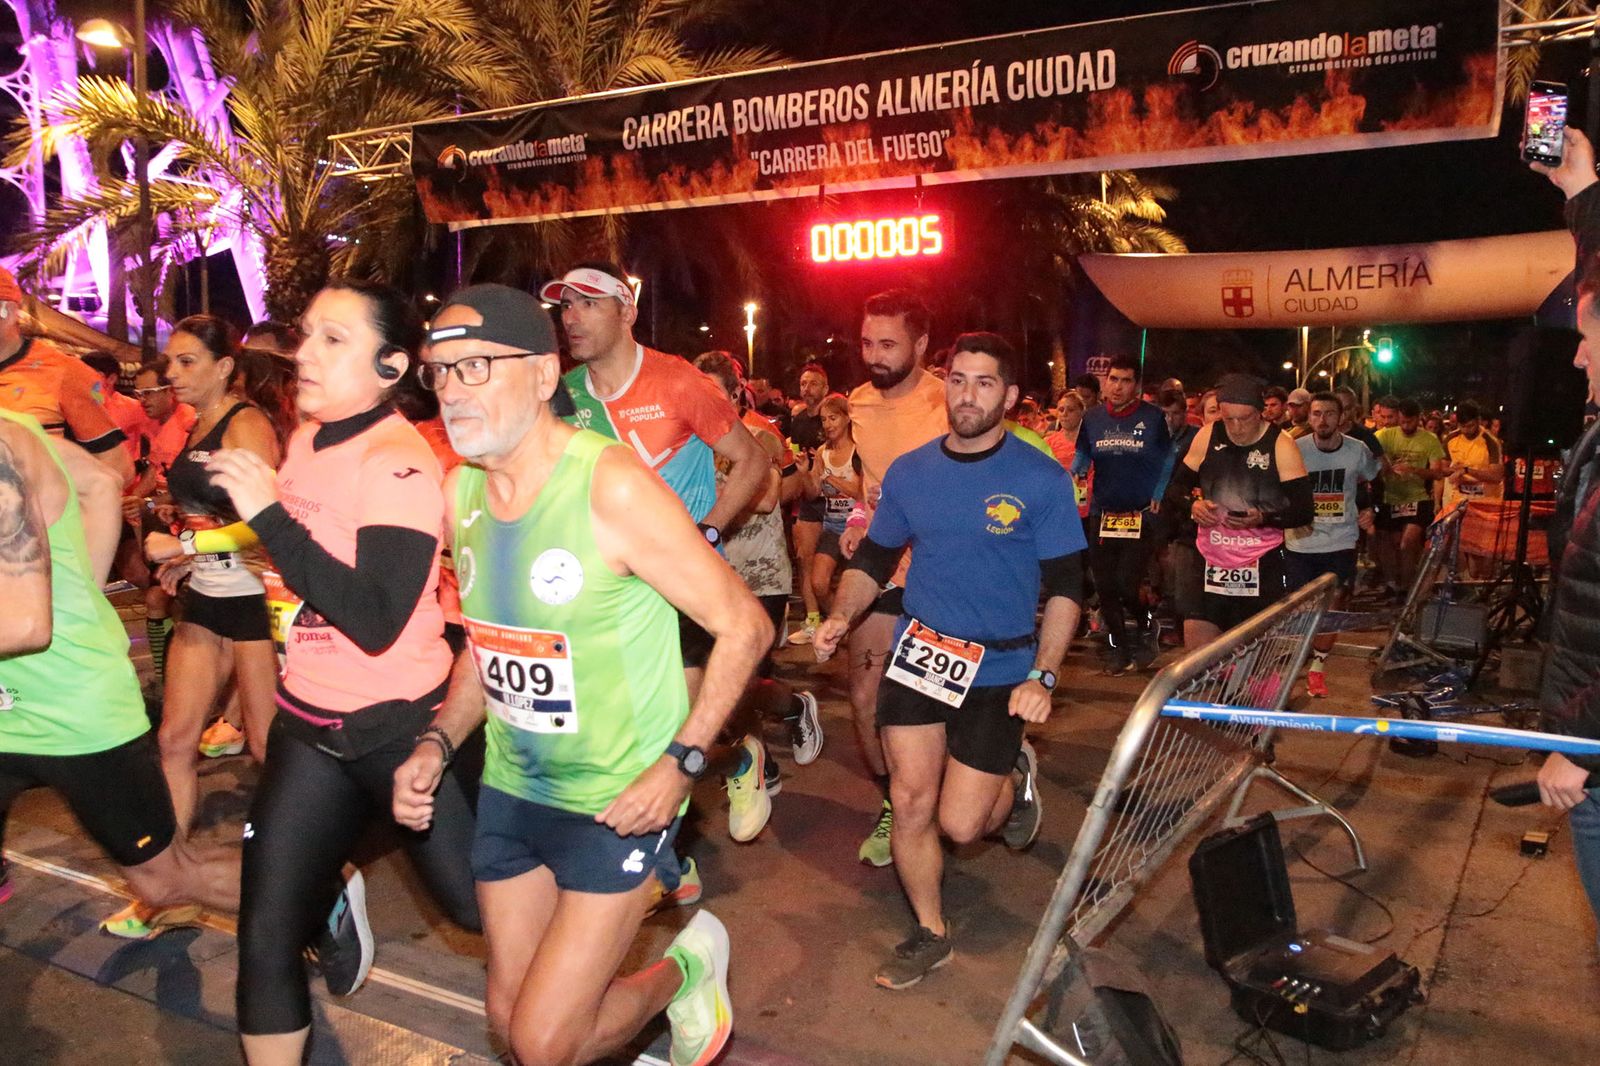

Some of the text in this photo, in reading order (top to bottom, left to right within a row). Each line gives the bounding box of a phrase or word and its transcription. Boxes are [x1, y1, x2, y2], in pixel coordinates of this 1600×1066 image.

[621, 49, 1117, 151] CARRERA BOMBEROS ALMERÍA CIUDAD
[845, 136, 880, 167] DEL
[1284, 256, 1433, 293] ALMERÍA
[1284, 296, 1359, 313] CIUDAD
[624, 404, 662, 417] CARRERA
[629, 411, 665, 423] POPULAR
[1095, 439, 1144, 448] STOCKHOLM
[1210, 530, 1261, 546] Sorbas
[1219, 568, 1252, 582] 260
[295, 631, 333, 644] Joma
[914, 645, 968, 682] 290
[487, 655, 555, 697] 409
